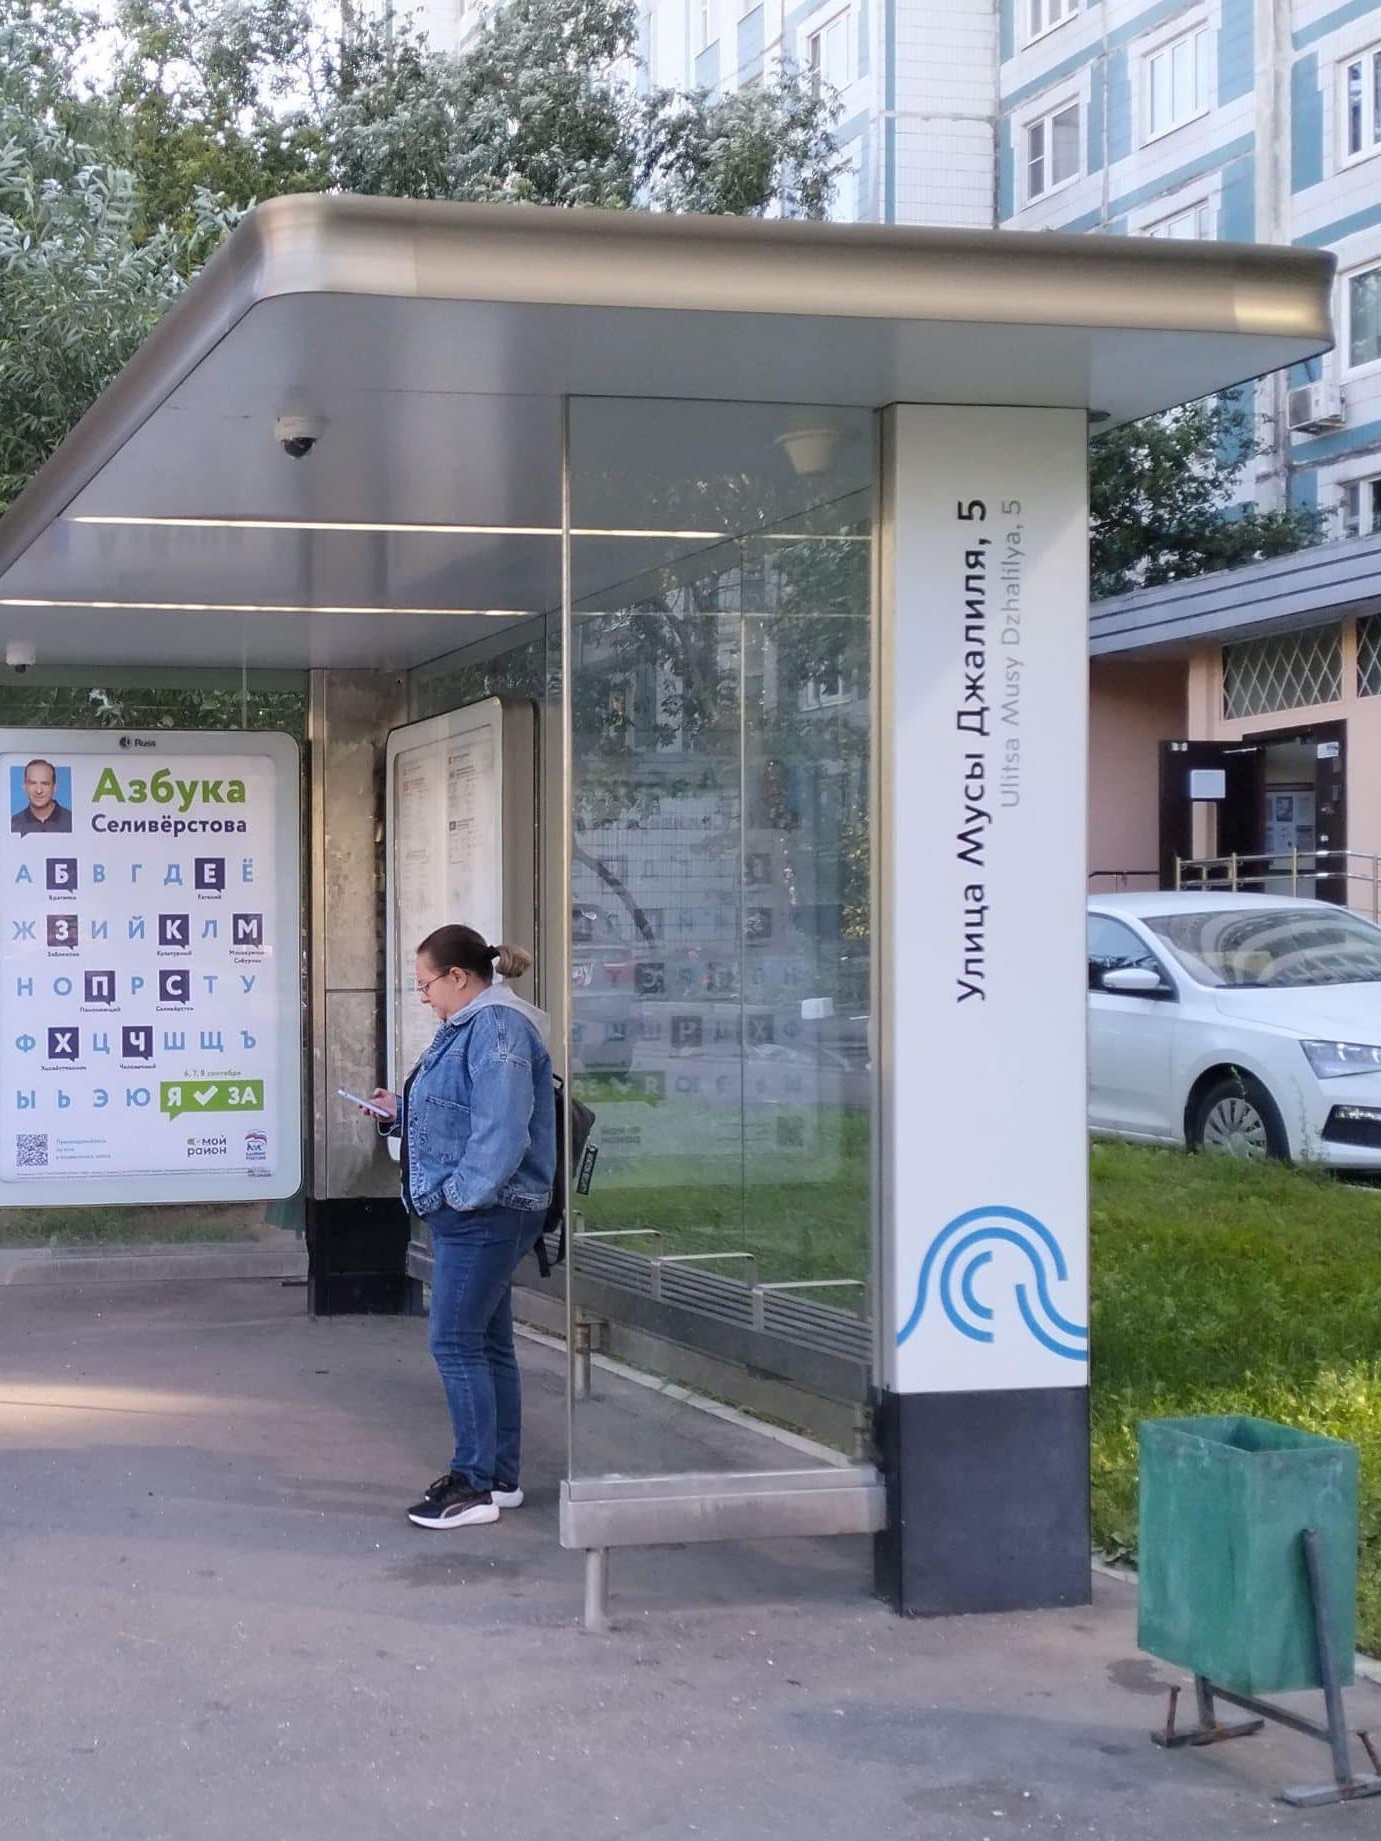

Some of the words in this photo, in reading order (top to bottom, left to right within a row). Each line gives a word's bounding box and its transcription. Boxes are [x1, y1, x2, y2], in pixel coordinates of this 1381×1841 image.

[957, 499, 987, 522] 5
[1001, 499, 1021, 515] 5
[1001, 523, 1026, 646] Dzhalilya,
[957, 538, 992, 737] Джалиля,
[1001, 656, 1025, 726] Musy
[1001, 738, 1021, 808] Ulitsa
[92, 767, 246, 813] Азбука
[957, 753, 992, 866] Мусы
[91, 814, 247, 837] Селивёрстова
[15, 864, 33, 883] А
[55, 864, 69, 884] Б
[92, 864, 106, 883] В
[131, 864, 142, 883] Г
[163, 864, 183, 886] Д
[203, 864, 217, 883] Е
[242, 858, 254, 882] Ё
[12, 920, 37, 940] Ж
[55, 920, 69, 940] З
[91, 920, 108, 939] И
[128, 915, 145, 939] Й
[166, 919, 183, 939] К
[201, 919, 218, 939] Л
[238, 919, 258, 939] М
[957, 884, 989, 1002] Улица
[17, 977, 33, 997] Н
[53, 977, 73, 996] О
[92, 976, 108, 996] П
[131, 976, 145, 995] Р
[166, 975, 182, 995] С
[203, 976, 218, 994] Т
[240, 975, 256, 994] У
[15, 1034, 37, 1053] Ф
[54, 1033, 73, 1053] Х
[92, 1033, 110, 1054] Ц
[129, 1031, 145, 1052] Ч
[163, 1031, 186, 1051] Ш
[200, 1031, 224, 1053] Щ
[240, 1030, 257, 1049] Ъ
[16, 1090, 36, 1109] Ы
[58, 1089, 71, 1109] Ь
[93, 1088, 109, 1108] Э
[126, 1087, 151, 1107] Ю
[167, 1086, 182, 1107] Я
[227, 1086, 258, 1105] ЗА
